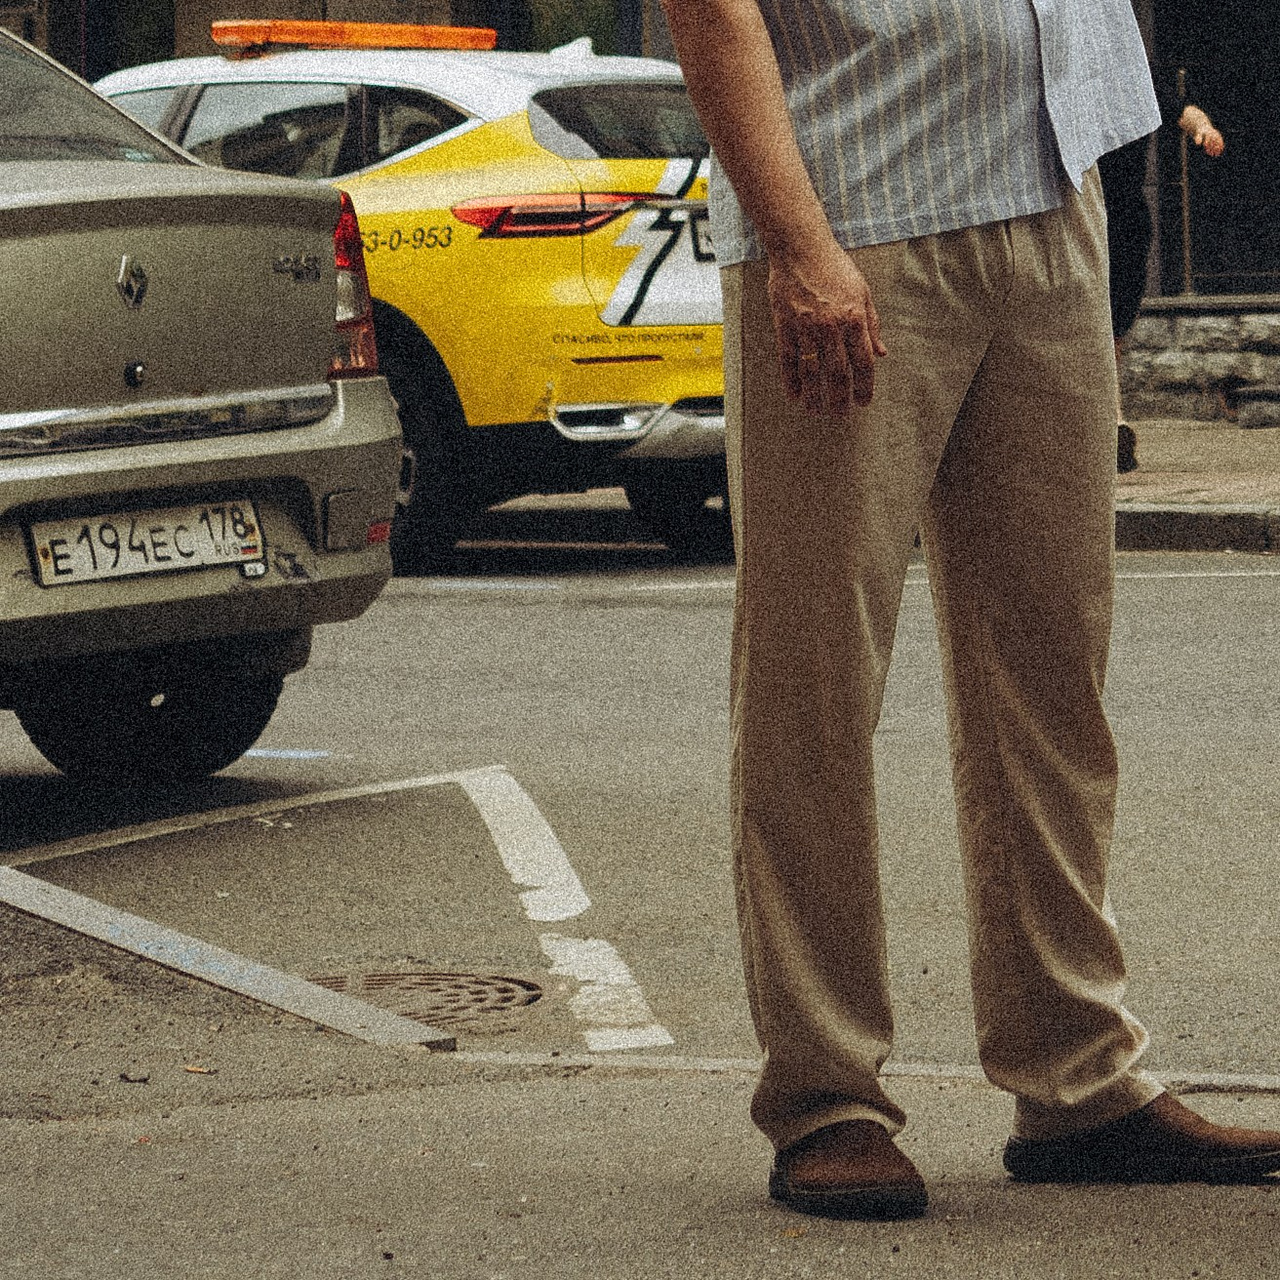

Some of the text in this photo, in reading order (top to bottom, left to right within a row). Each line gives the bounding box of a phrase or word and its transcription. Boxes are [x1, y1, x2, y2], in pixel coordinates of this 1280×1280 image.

[361, 226, 453, 253] 3-0-953
[199, 505, 247, 542] 178
[214, 541, 240, 556] RUS
